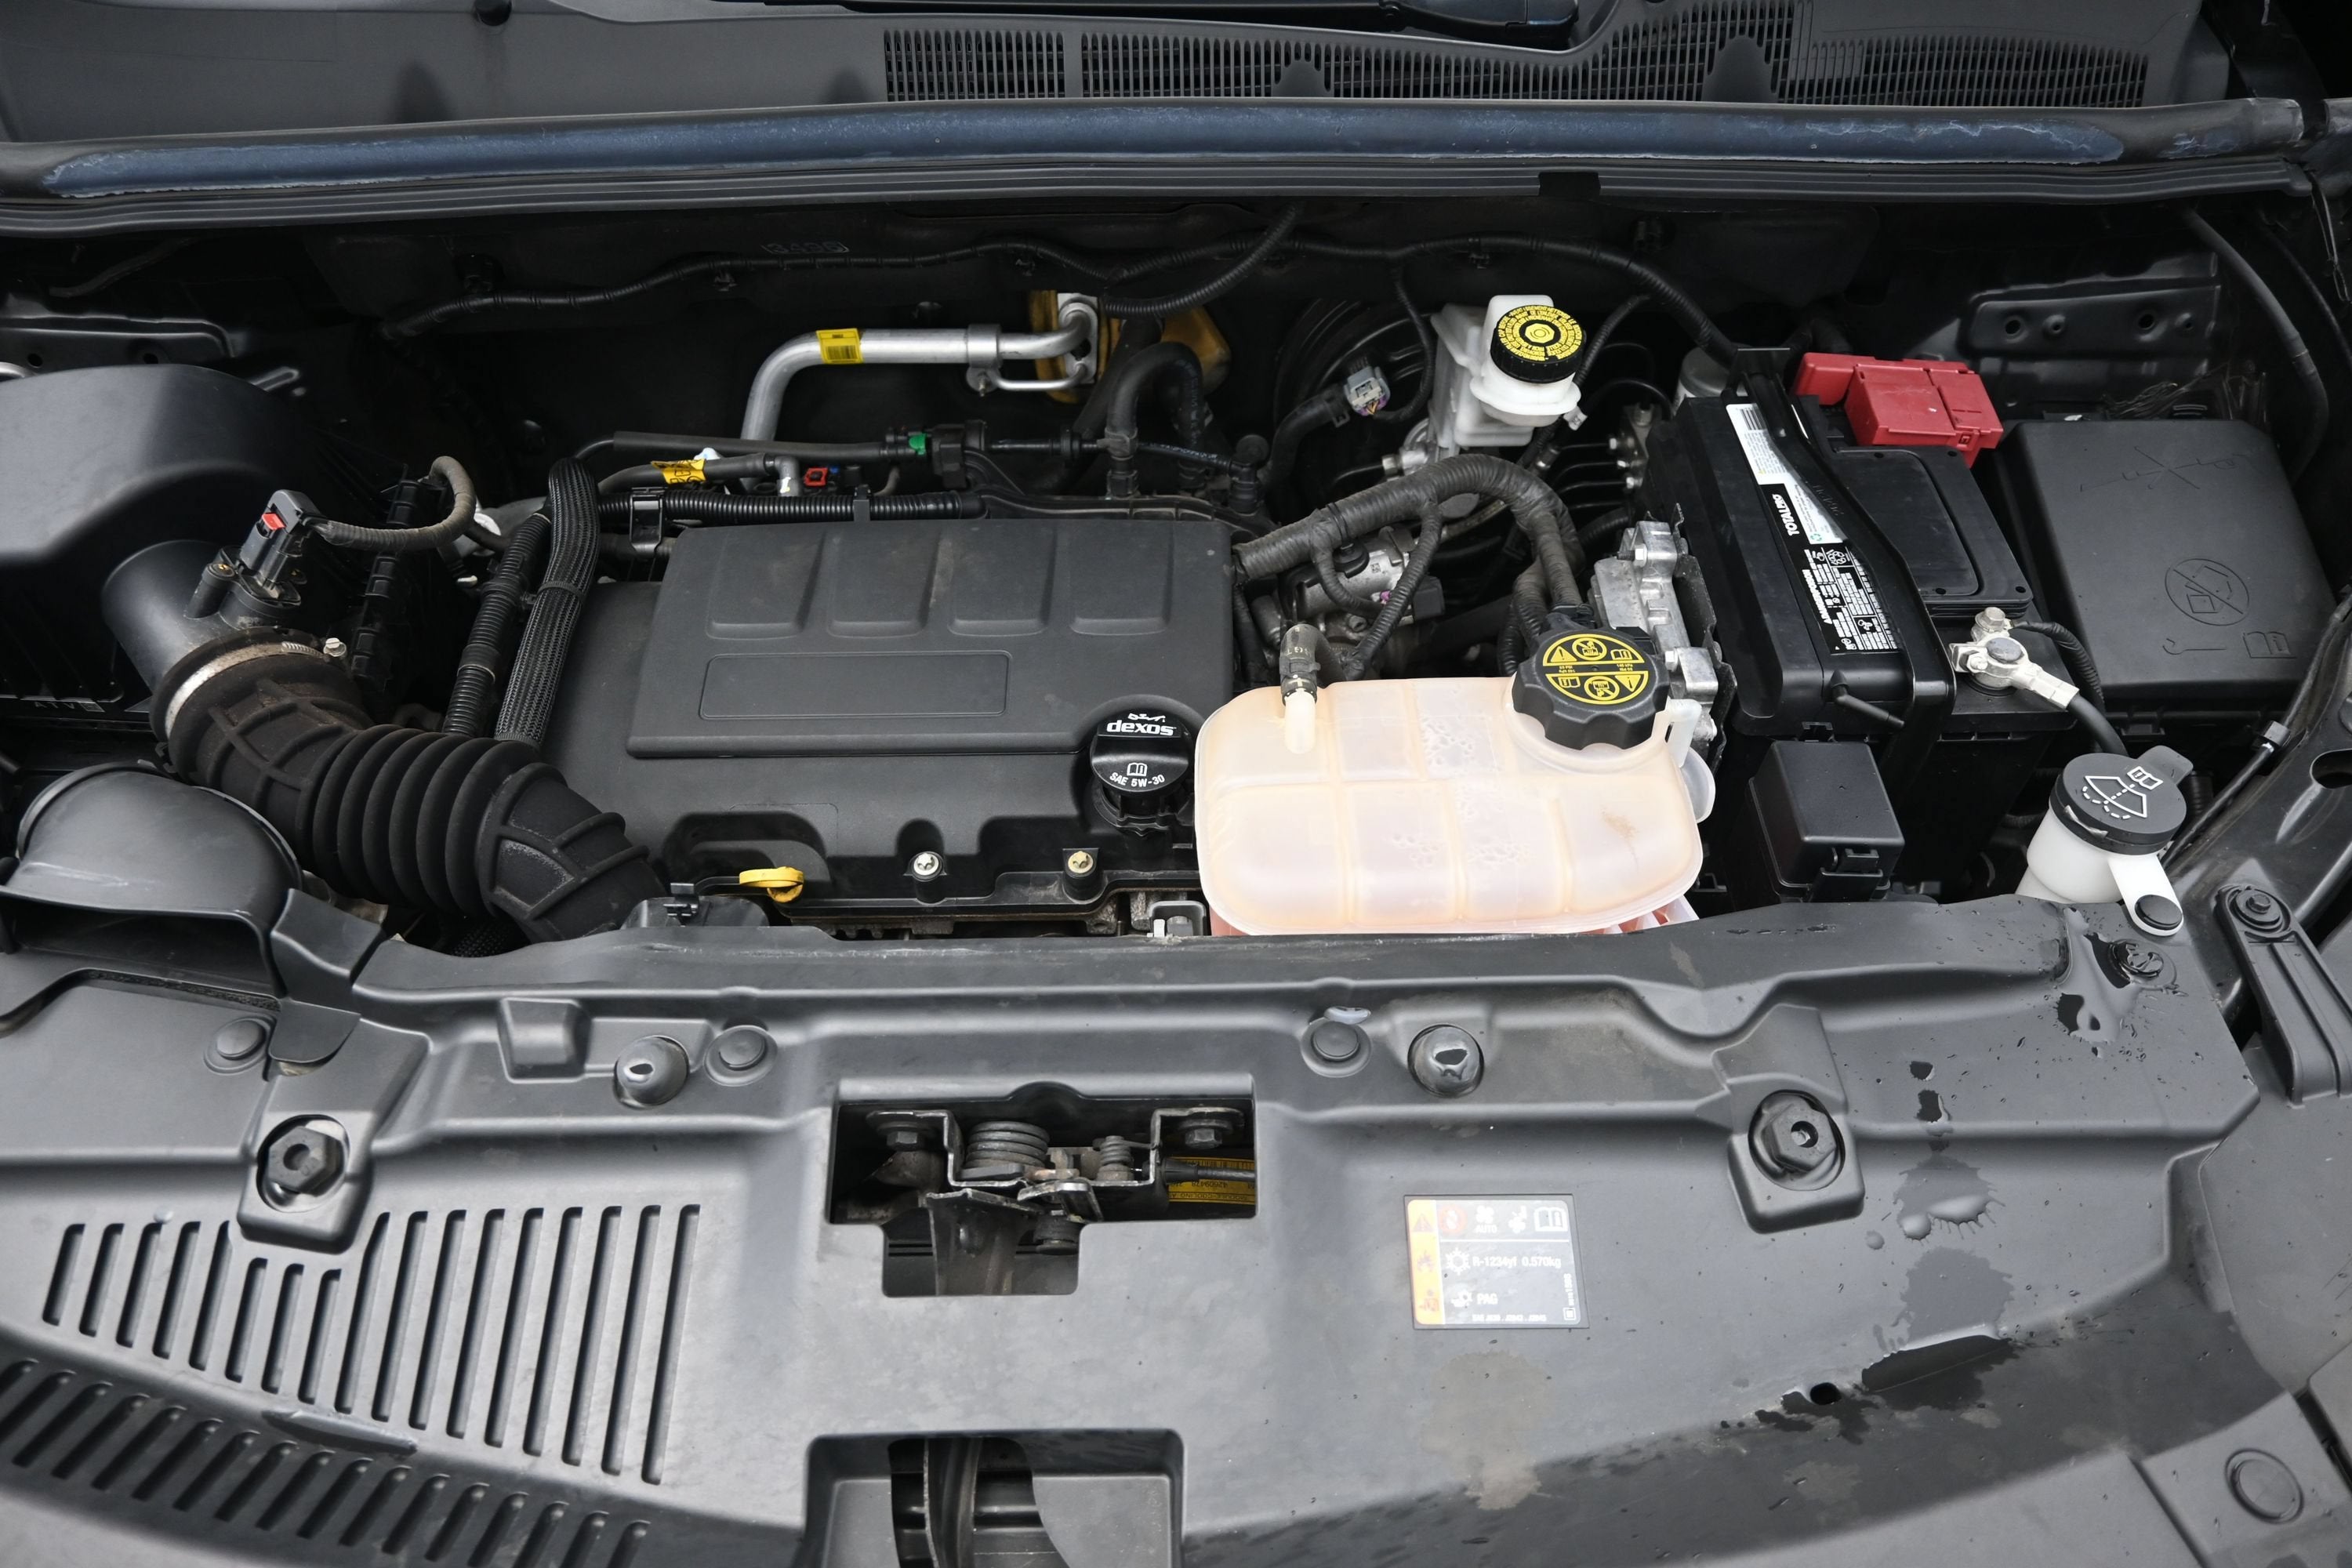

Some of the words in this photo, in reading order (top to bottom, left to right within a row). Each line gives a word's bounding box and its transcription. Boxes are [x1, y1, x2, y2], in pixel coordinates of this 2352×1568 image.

[1106, 720, 1175, 736] dexos
[1109, 771, 1128, 786] SAE
[1131, 774, 1165, 787] 5W-30
[1475, 1224, 1497, 1234] AUTO
[1521, 1256, 1562, 1269] 0.570kg
[1477, 1293, 1499, 1305] PAG
